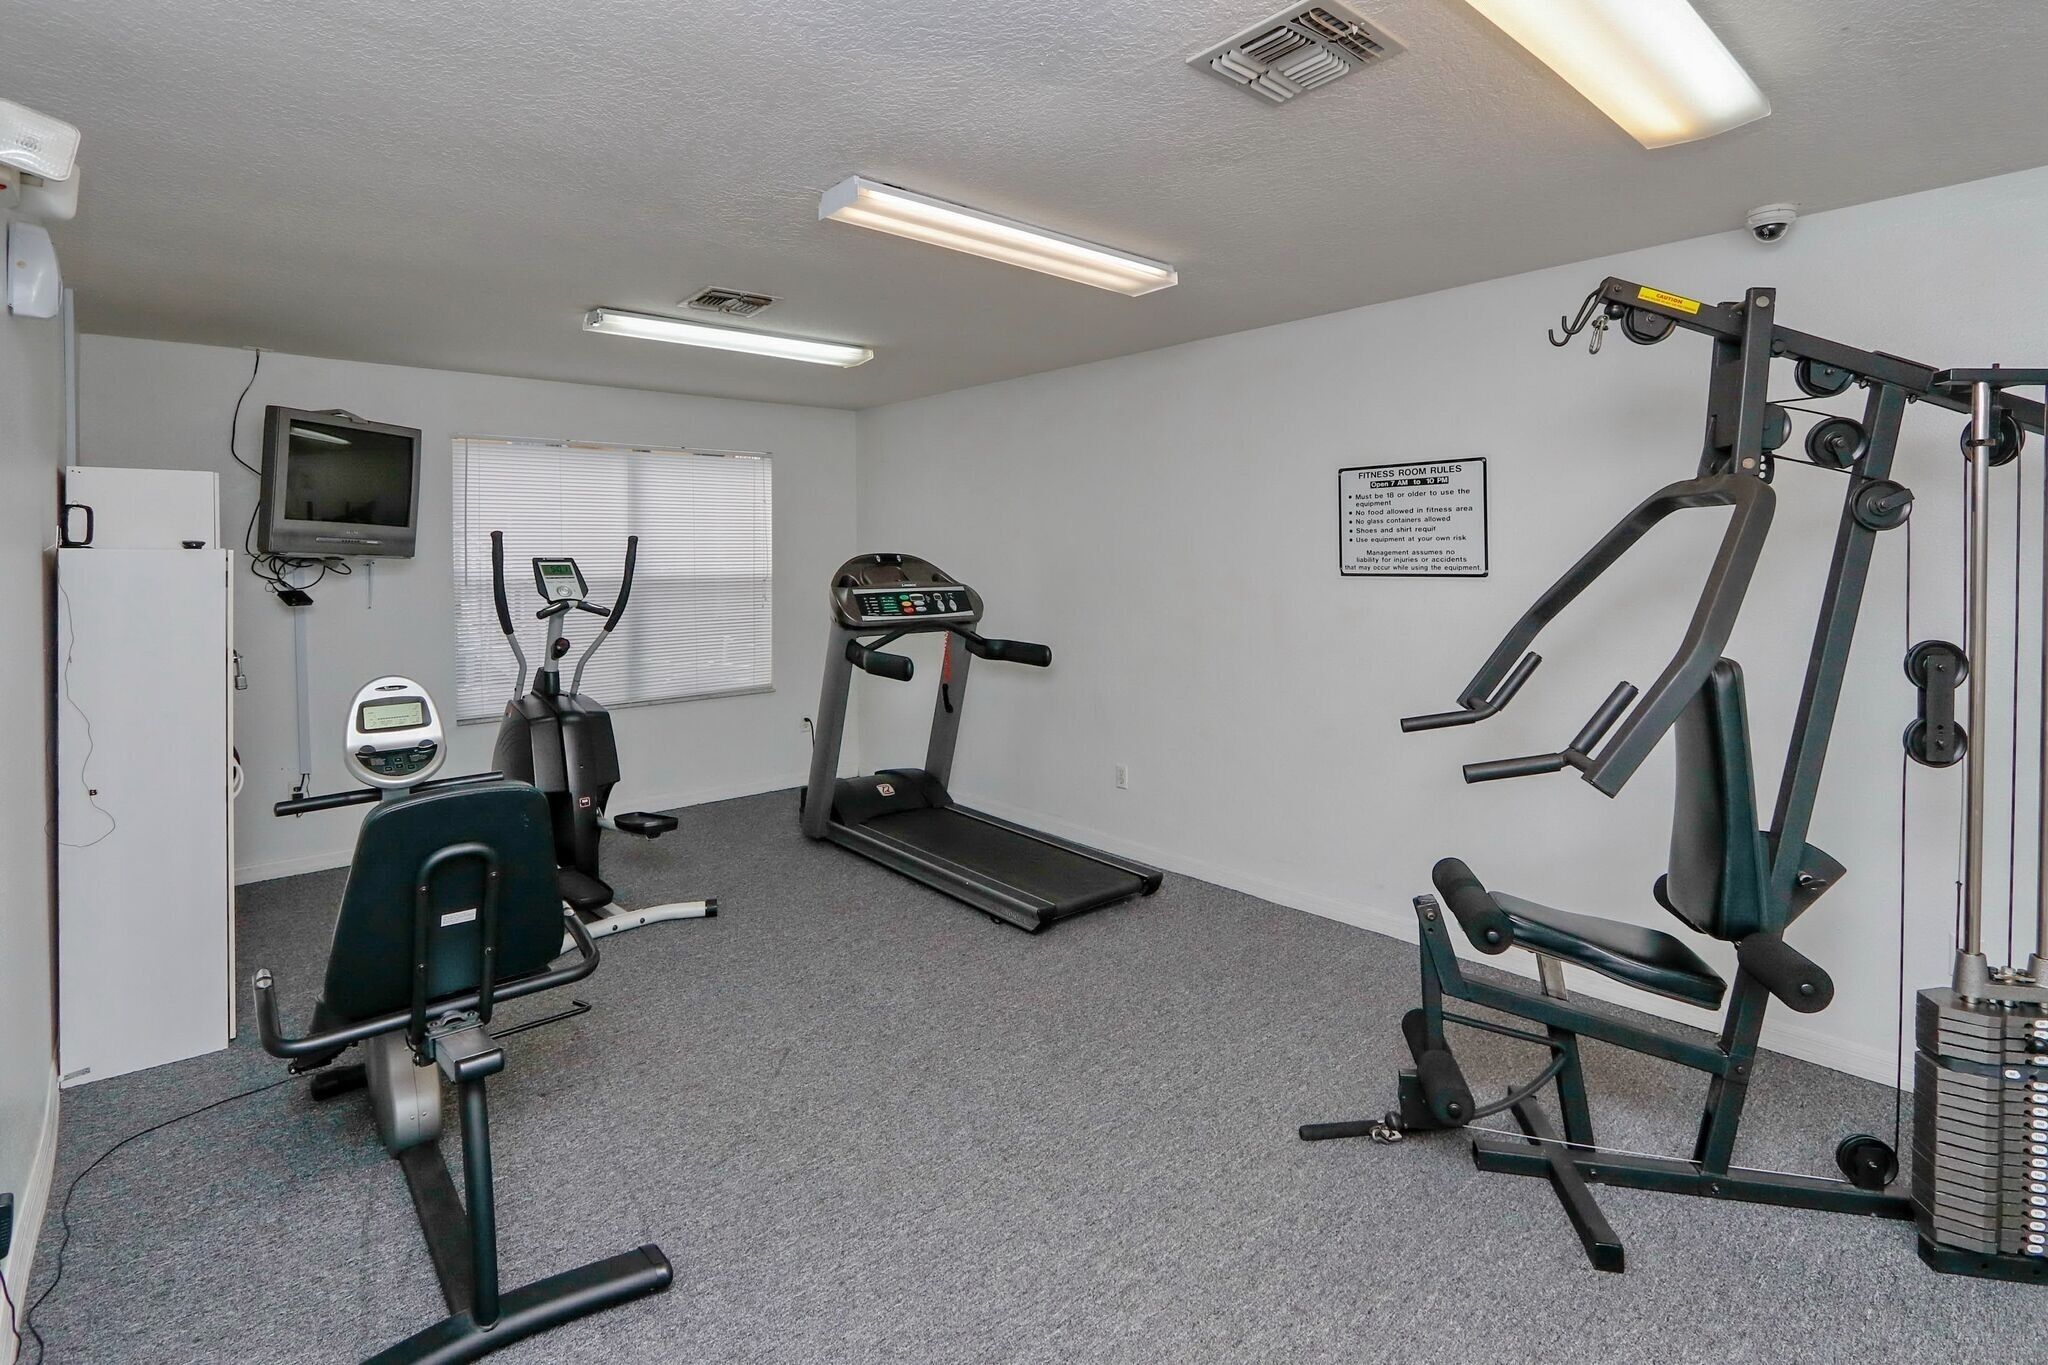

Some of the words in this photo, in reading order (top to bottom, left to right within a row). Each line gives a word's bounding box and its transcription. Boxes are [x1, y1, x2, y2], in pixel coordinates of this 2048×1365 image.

[1656, 294, 1683, 304] CAUTION
[1358, 470, 1394, 479] FITNESS
[1398, 468, 1426, 476] ROOM
[1431, 465, 1462, 474] RULES
[1356, 500, 1391, 508] equipment
